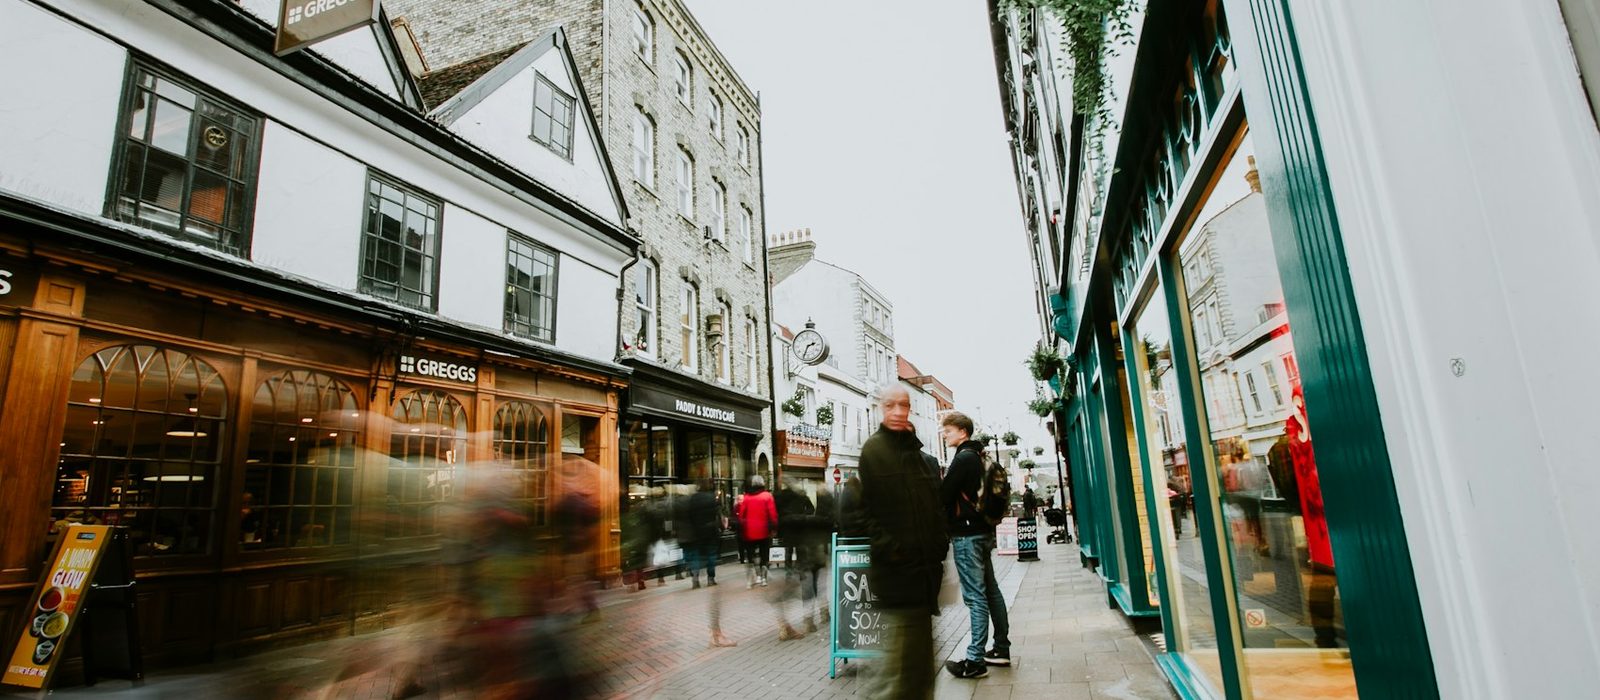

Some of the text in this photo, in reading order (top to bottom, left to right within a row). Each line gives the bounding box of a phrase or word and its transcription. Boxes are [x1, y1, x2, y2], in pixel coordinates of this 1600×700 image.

[304, 0, 356, 18] GRE
[416, 358, 476, 382] GREGGS
[675, 399, 696, 415] PADDY
[696, 405, 702, 416] &
[1017, 525, 1037, 533] SHOP
[1017, 532, 1037, 540] OPEN
[58, 547, 97, 569] A WARM
[51, 568, 88, 590] GLOW
[864, 602, 872, 610] TO
[849, 610, 881, 630] 50%
[857, 630, 881, 646] NOW!
